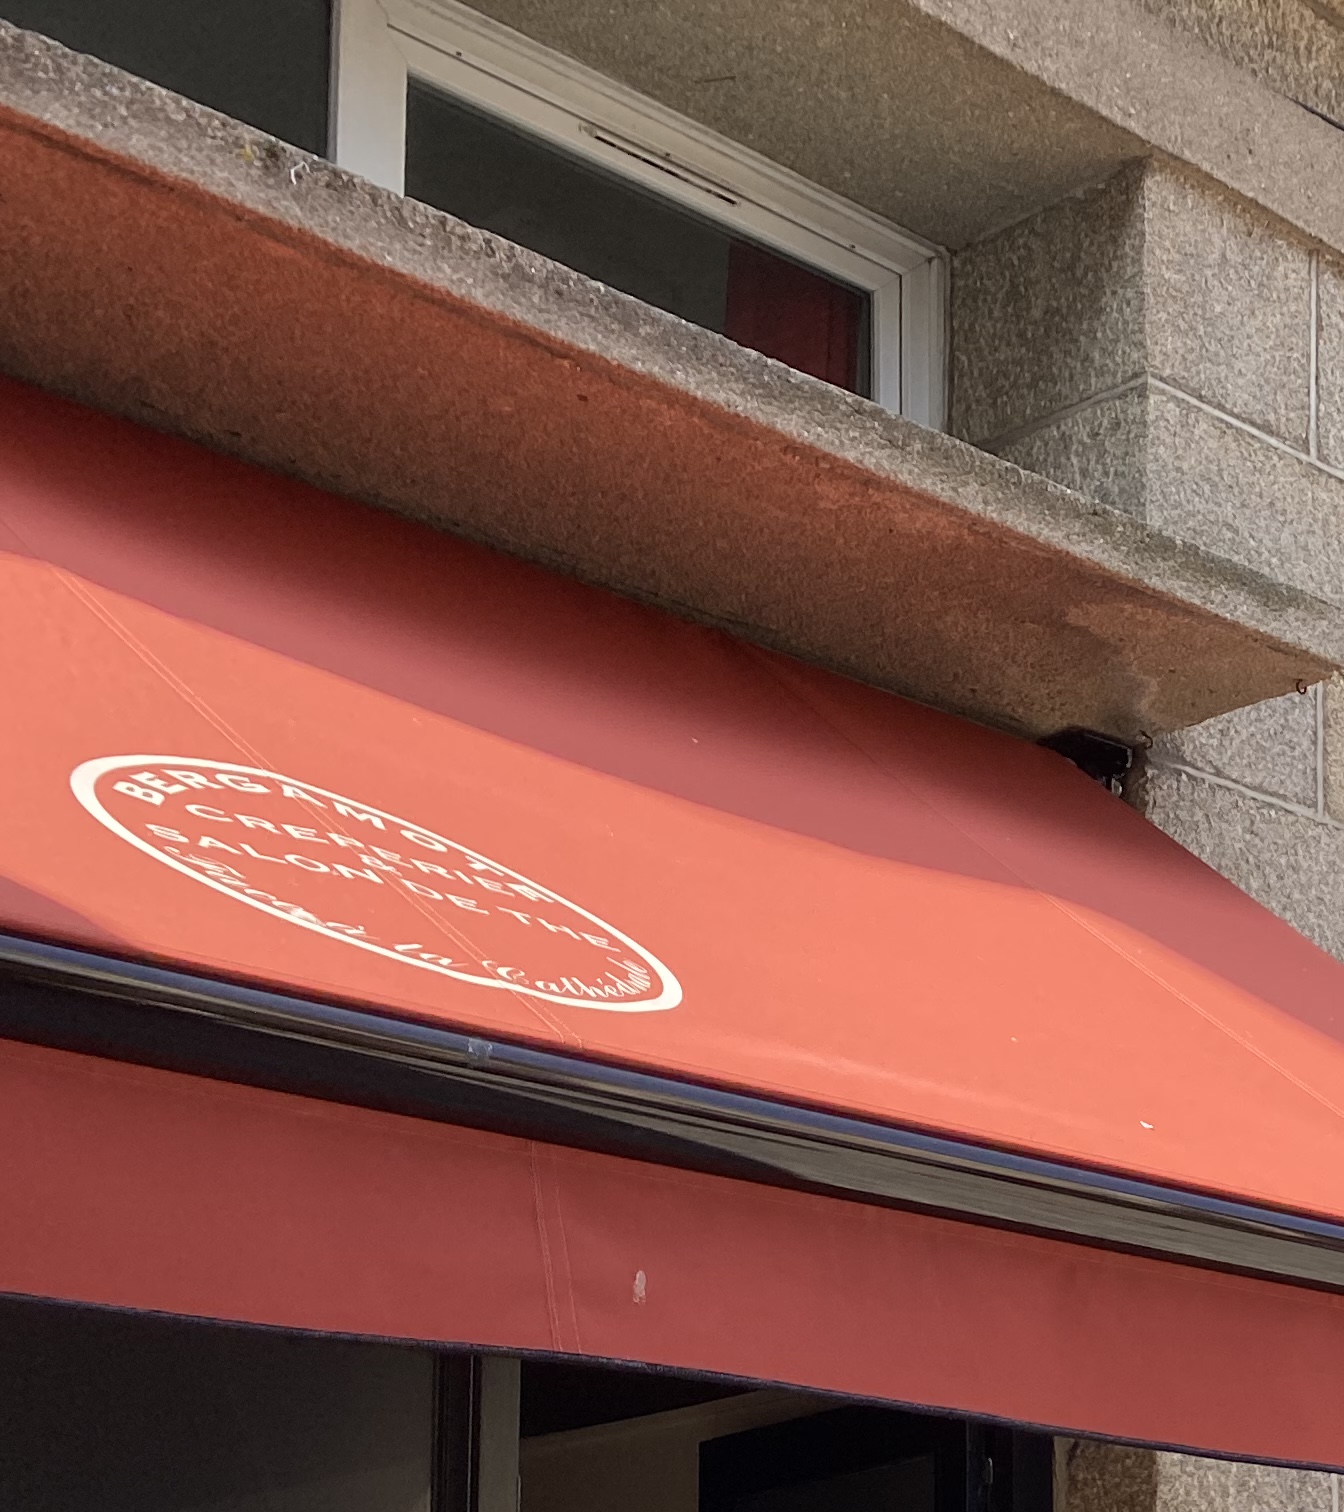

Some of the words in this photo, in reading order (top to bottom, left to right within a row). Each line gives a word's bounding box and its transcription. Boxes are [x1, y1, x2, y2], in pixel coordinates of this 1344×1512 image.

[112, 768, 555, 903] BERGAMOTE
[145, 823, 384, 884] SALON
[401, 878, 490, 914] DE
[496, 905, 621, 952] THE
[185, 804, 515, 897] CREPERIE
[359, 853, 402, 877] &
